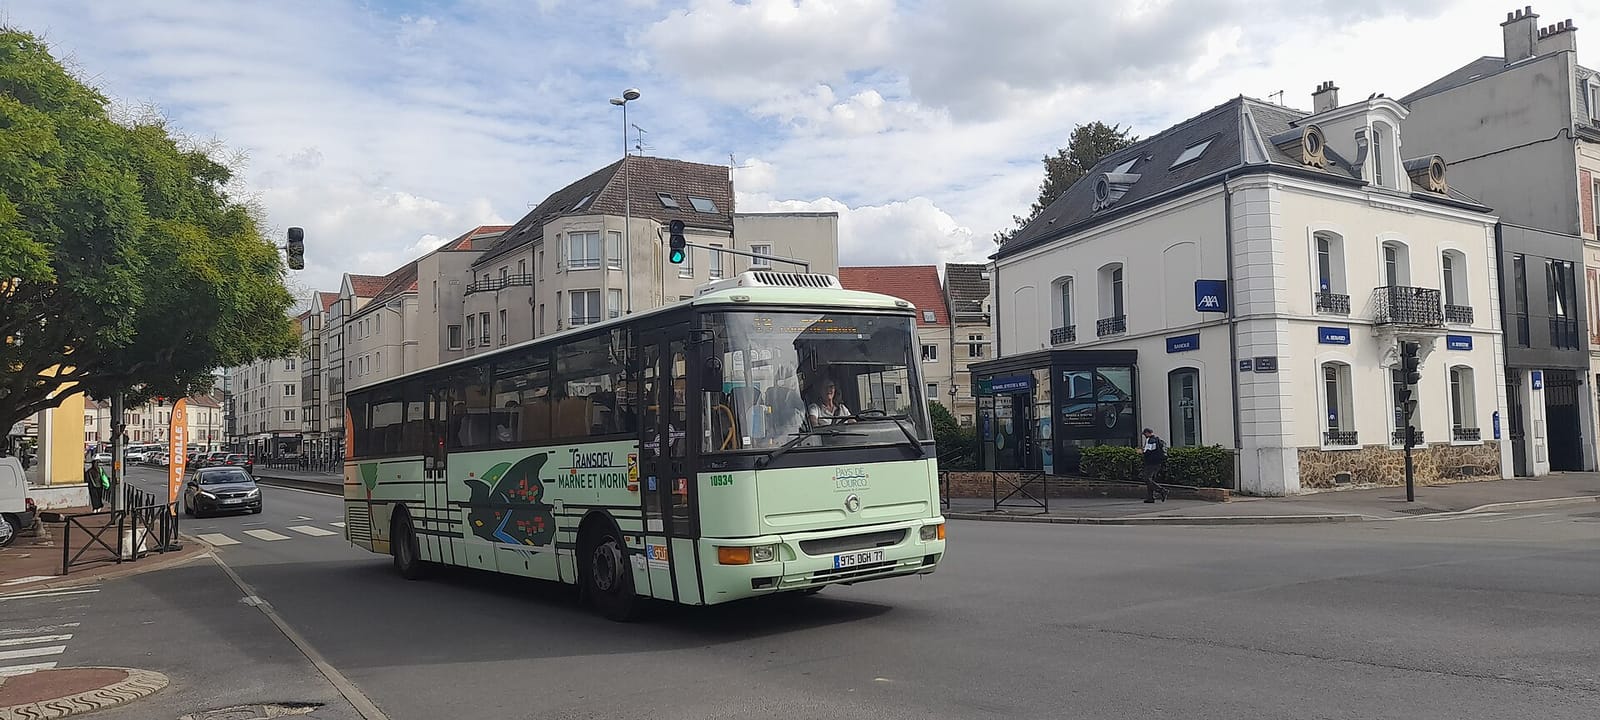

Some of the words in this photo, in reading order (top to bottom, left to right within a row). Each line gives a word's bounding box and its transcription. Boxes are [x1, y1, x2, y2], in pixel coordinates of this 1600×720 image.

[1198, 295, 1219, 307] AXA
[174, 426, 183, 464] DALLE
[836, 467, 853, 476] PAYS
[855, 467, 865, 475] DE
[558, 473, 585, 488] MARNE
[588, 473, 597, 488] ET
[600, 472, 627, 488] MORIN
[711, 474, 733, 486] 10934
[840, 555, 855, 566] 975
[873, 550, 883, 561] 77
